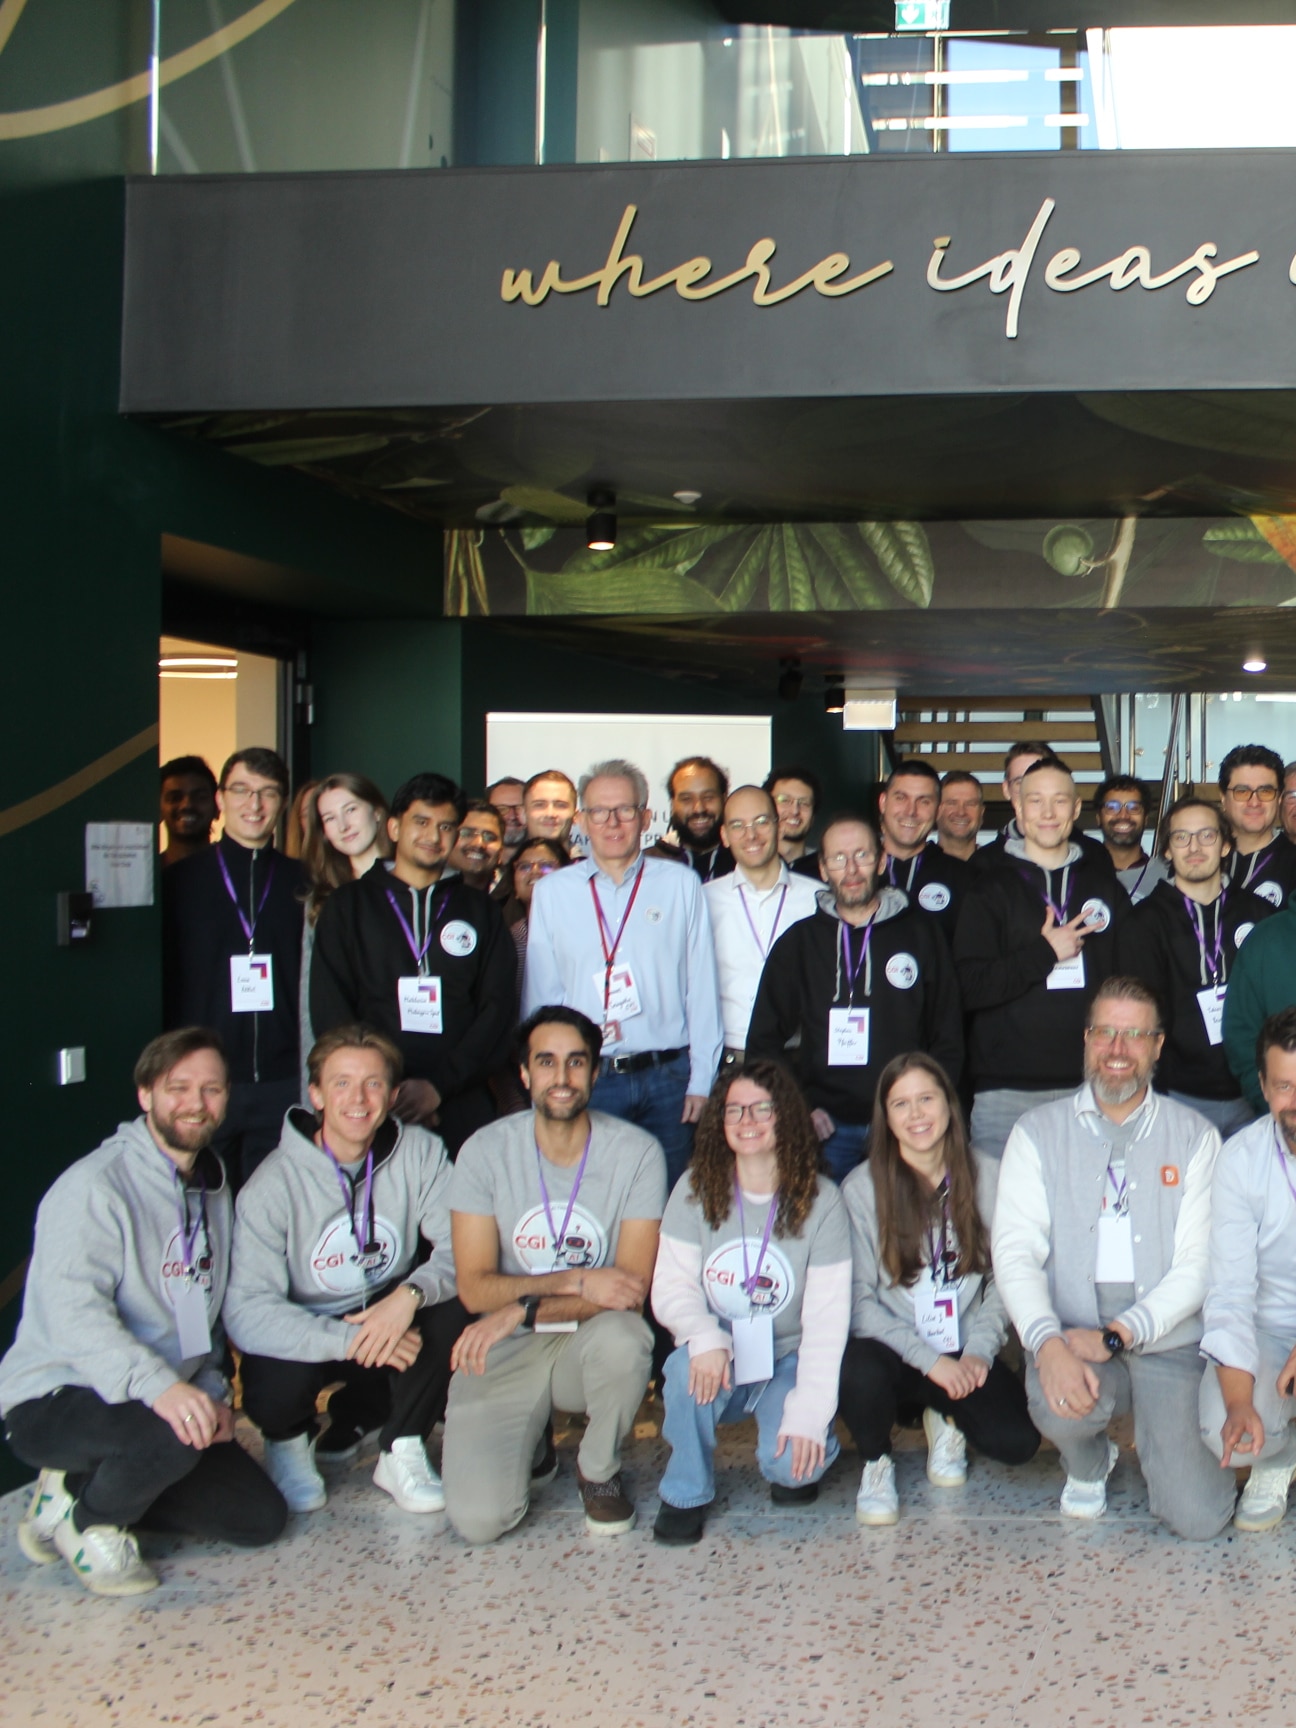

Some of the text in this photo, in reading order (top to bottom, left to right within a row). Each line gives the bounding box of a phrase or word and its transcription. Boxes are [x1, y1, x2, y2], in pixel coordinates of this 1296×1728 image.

[501, 203, 894, 308] where
[927, 197, 1260, 339] ideas
[515, 1234, 546, 1250] CGI
[161, 1261, 185, 1279] CGI
[313, 1252, 345, 1272] CGI
[706, 1267, 735, 1287] CGI
